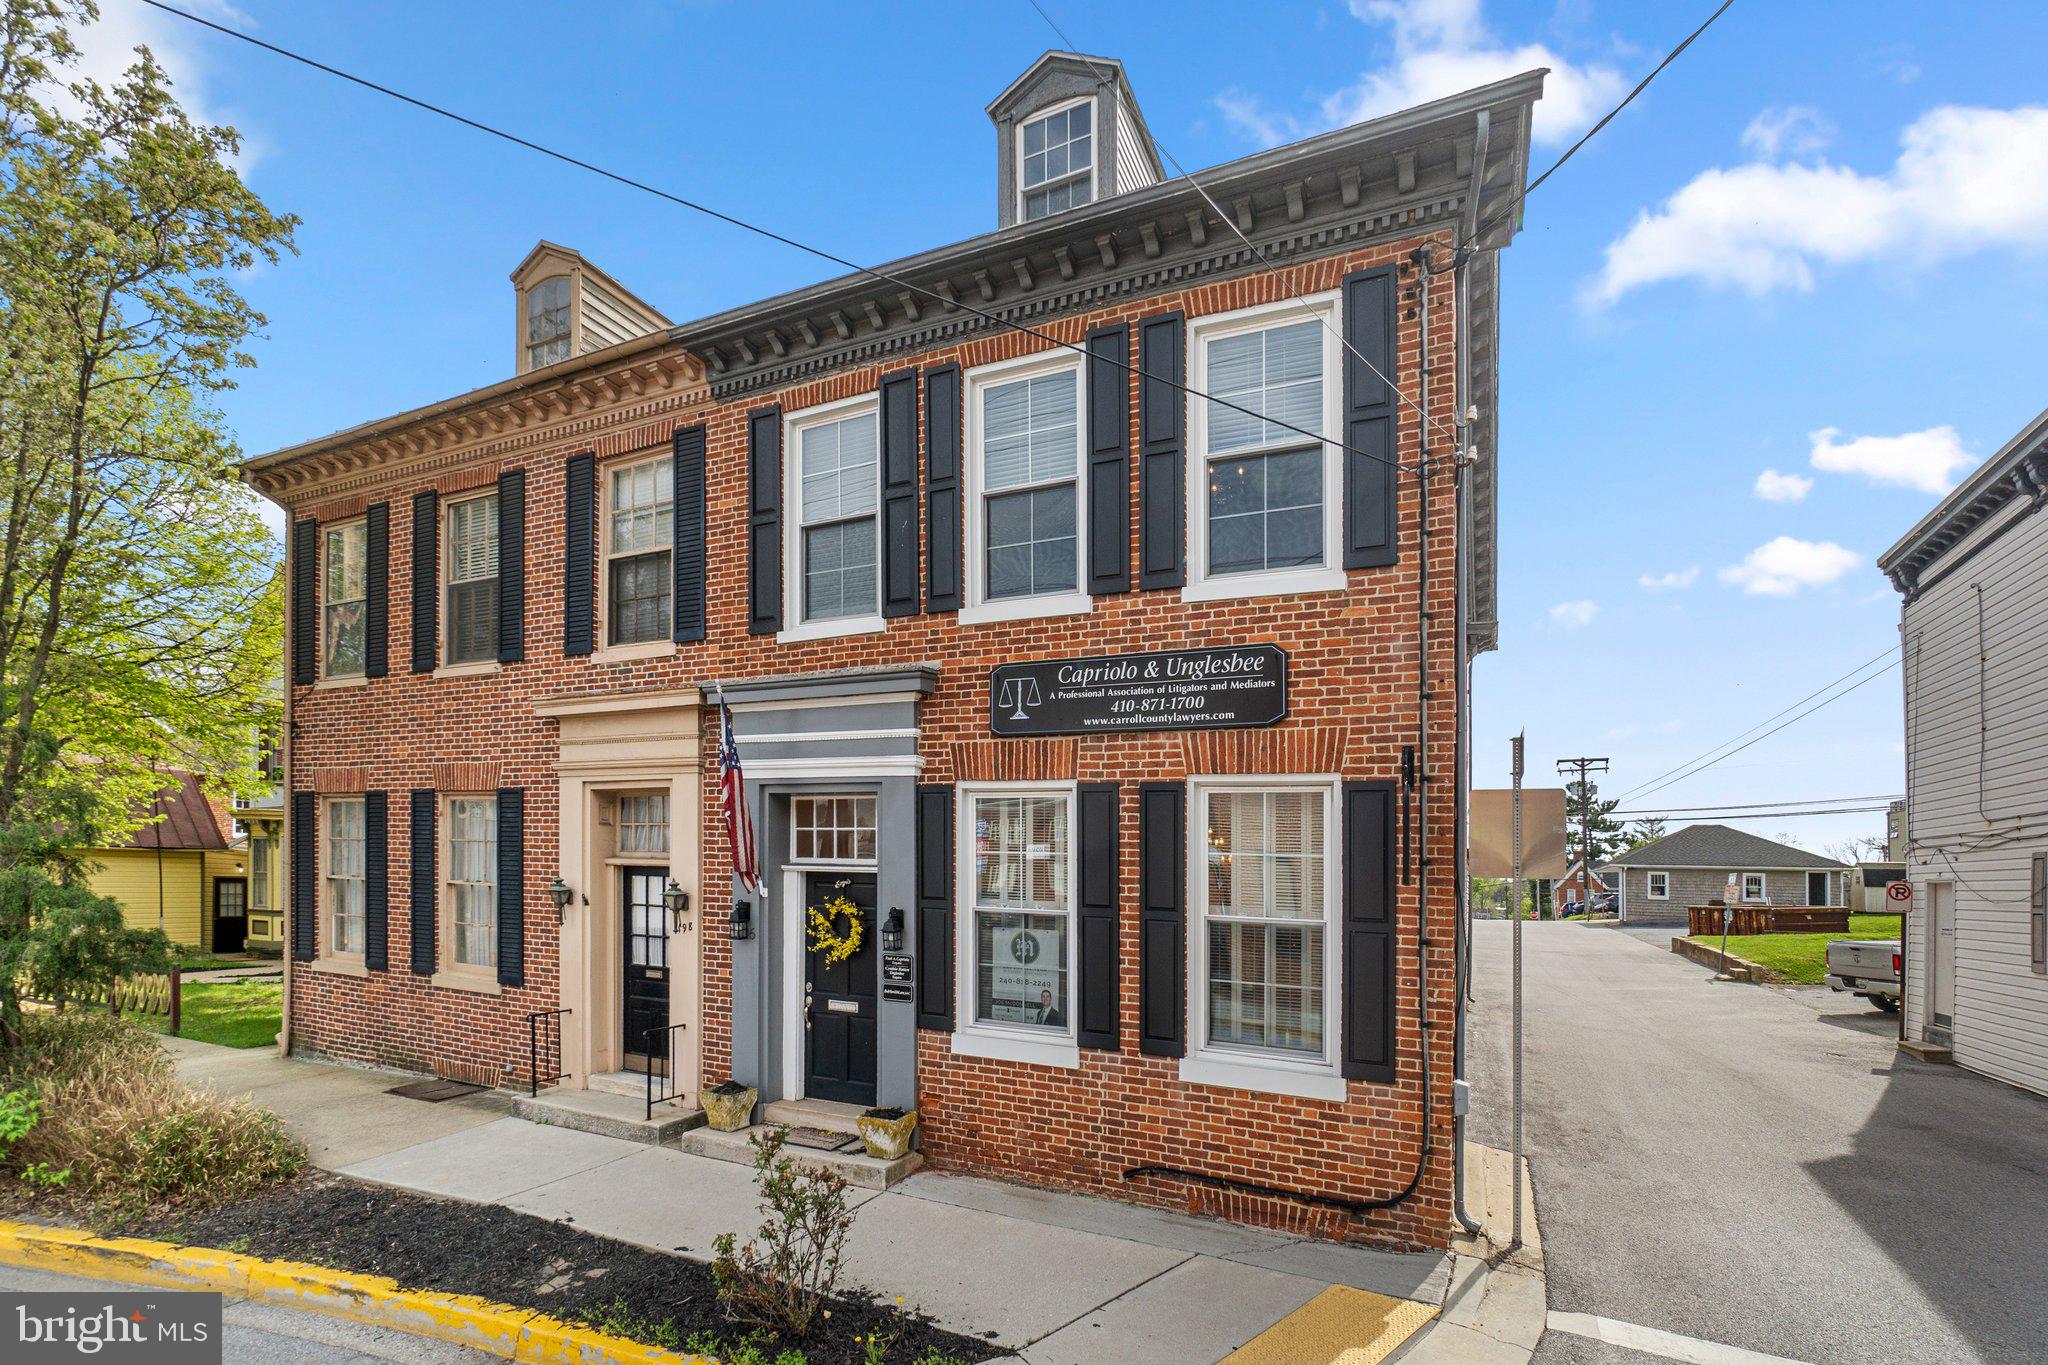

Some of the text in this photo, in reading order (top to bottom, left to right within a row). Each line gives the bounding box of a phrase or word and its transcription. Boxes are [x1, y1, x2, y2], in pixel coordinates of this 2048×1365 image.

[1058, 653, 1265, 687] Capriolo & Unglesbee
[1049, 679, 1276, 700] A Professional Association of Litigators and Mediators
[1110, 696, 1205, 713] 410-871-1700
[1083, 711, 1235, 726] www.carrollcountylawyers.com
